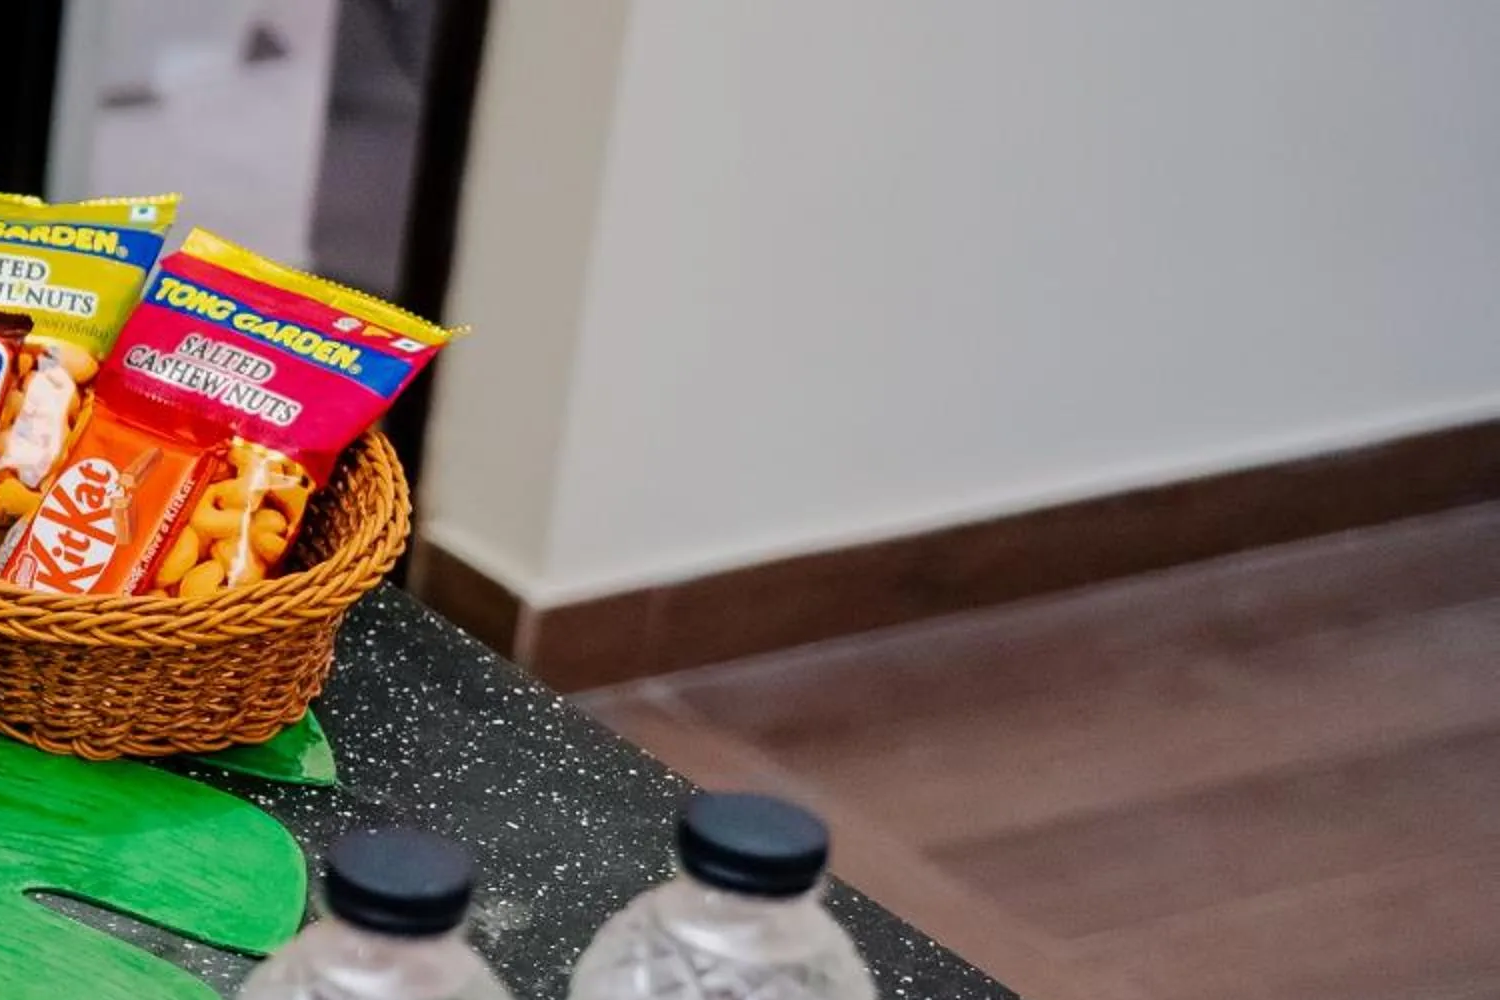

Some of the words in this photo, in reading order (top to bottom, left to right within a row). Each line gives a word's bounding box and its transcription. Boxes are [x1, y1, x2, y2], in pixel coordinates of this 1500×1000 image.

[24, 283, 95, 315] NUTS
[154, 277, 237, 320] TONG
[232, 311, 362, 370] GARDEN
[126, 347, 228, 396] CASHEW
[223, 384, 298, 423] NUTS
[180, 335, 273, 382] SALTED
